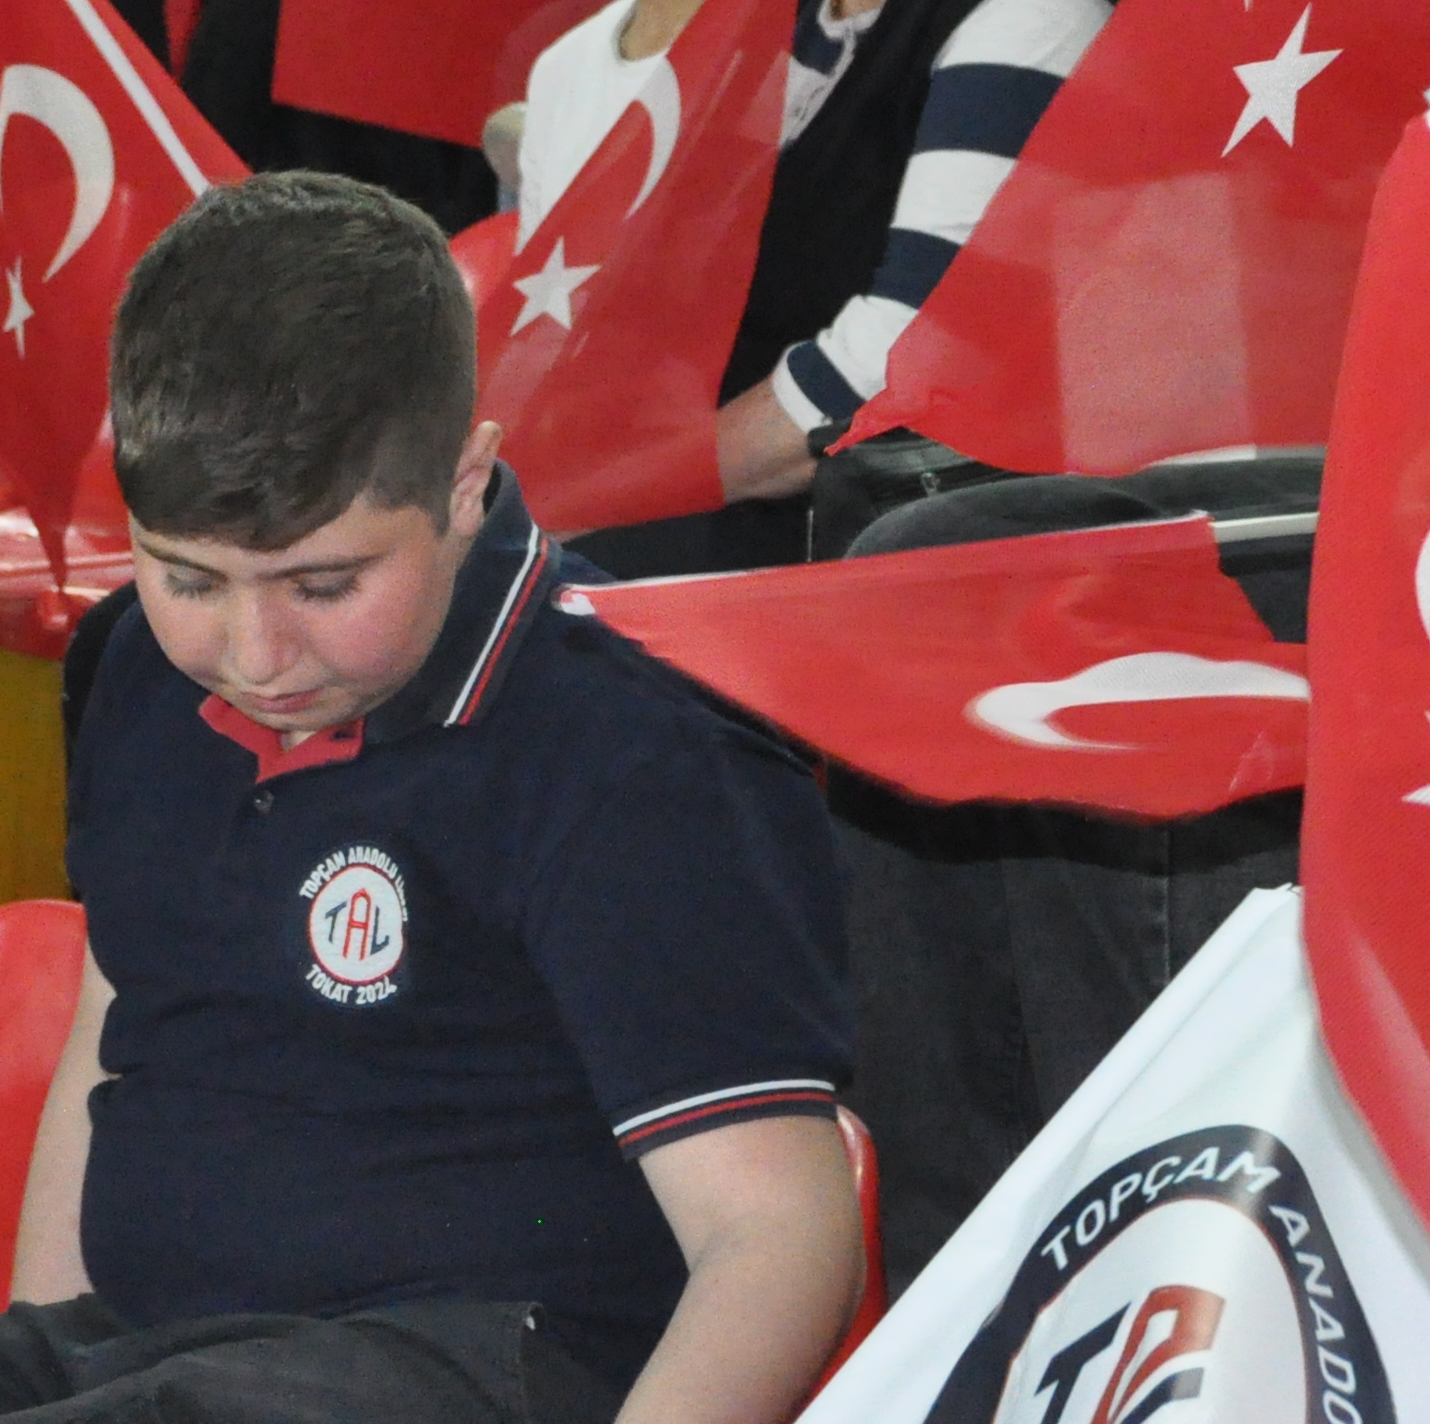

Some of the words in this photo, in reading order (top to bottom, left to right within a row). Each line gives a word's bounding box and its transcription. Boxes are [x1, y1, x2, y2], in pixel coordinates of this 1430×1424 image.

[347, 845, 399, 880] ANADOLU
[325, 887, 391, 962] TAL
[305, 963, 353, 1004] TOKAT
[355, 974, 398, 1006] 2024
[1040, 1146, 1282, 1272] TOPÇAM
